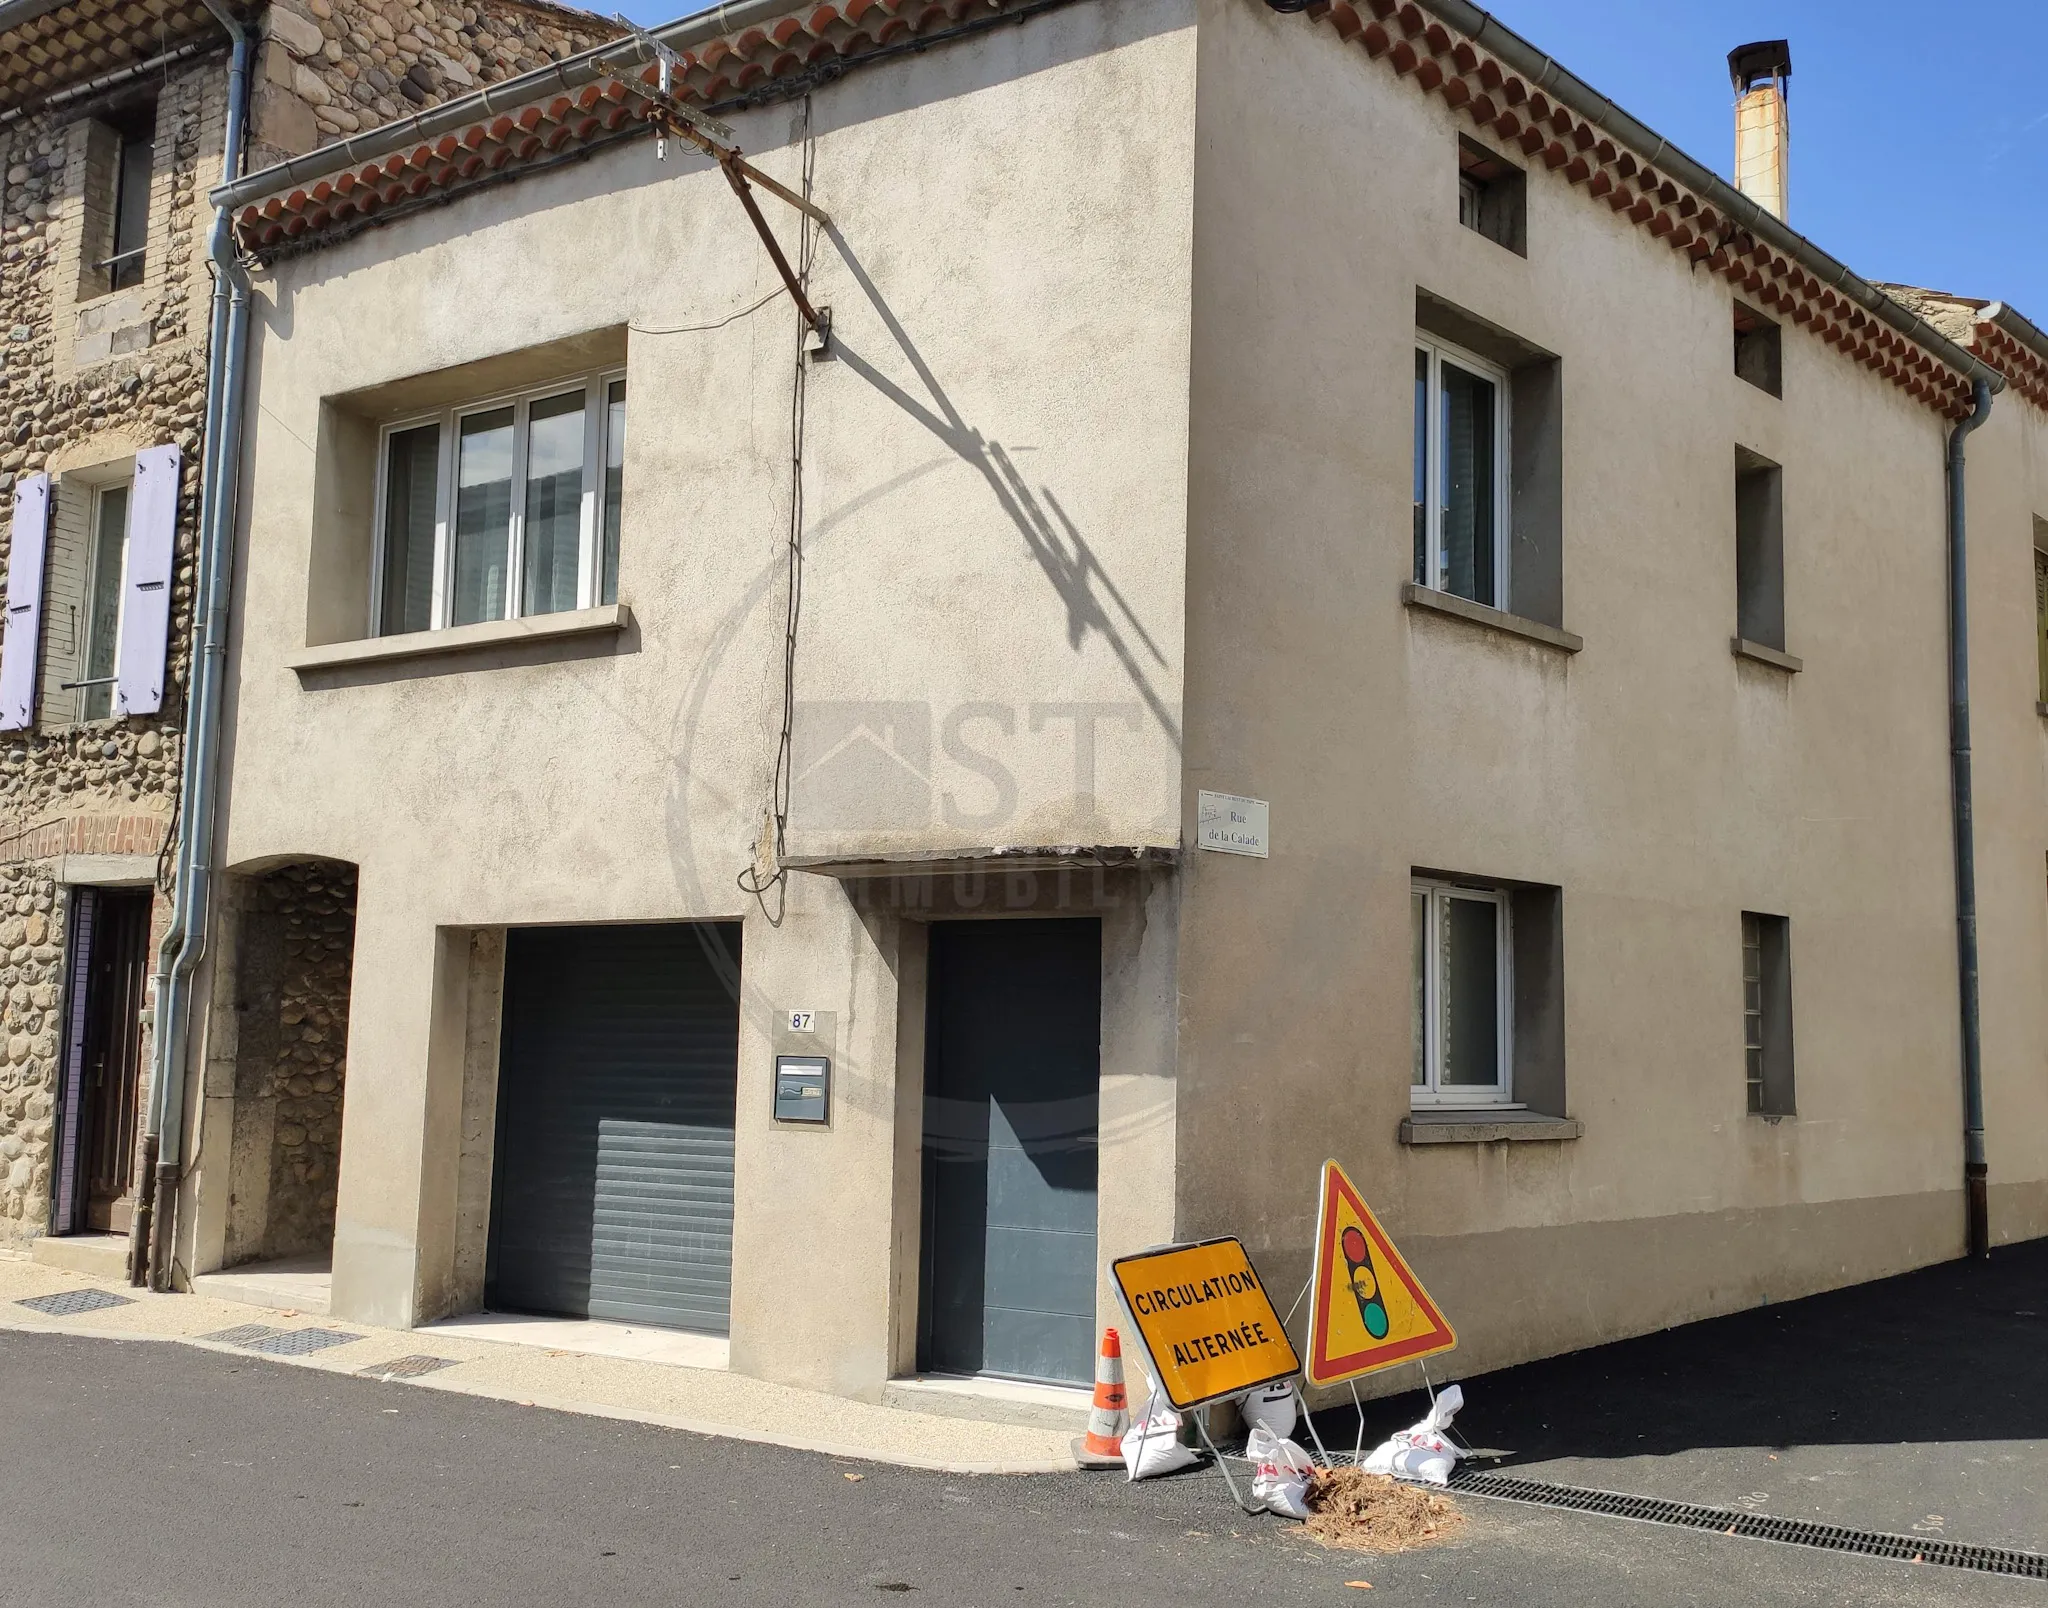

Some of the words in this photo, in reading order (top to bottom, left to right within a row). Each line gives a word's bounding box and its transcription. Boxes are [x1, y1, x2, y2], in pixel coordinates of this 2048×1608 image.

[1230, 811, 1247, 823] Rue
[1208, 829, 1218, 840] de
[1221, 830, 1229, 842] la
[1231, 832, 1260, 846] Calade
[792, 1013, 810, 1028] 87
[1134, 1270, 1257, 1316] CIRCULATION
[1172, 1321, 1270, 1367] ALTERNÉE
